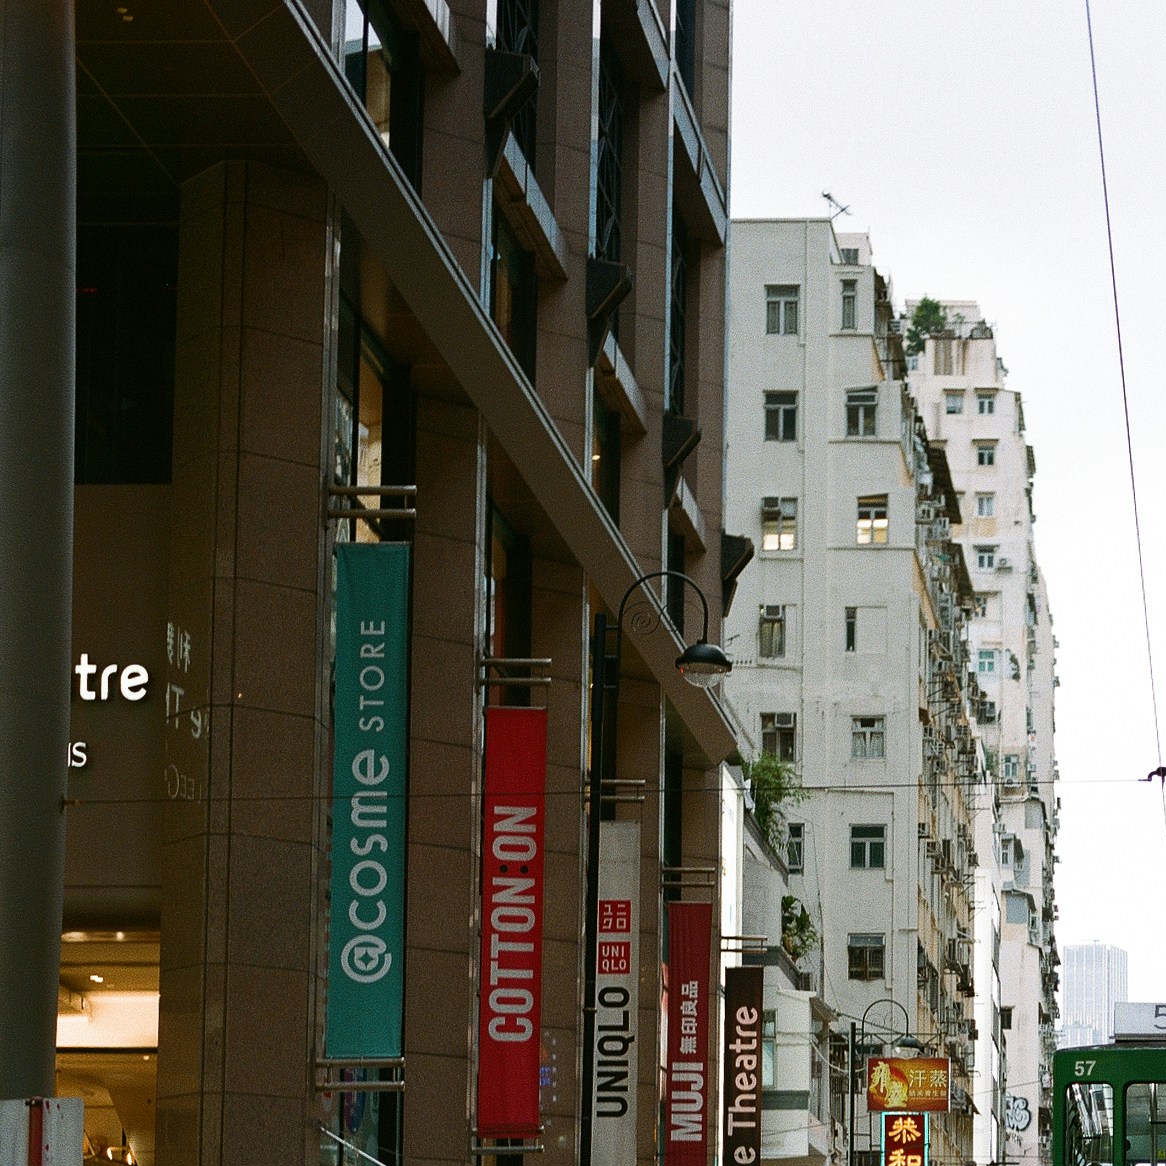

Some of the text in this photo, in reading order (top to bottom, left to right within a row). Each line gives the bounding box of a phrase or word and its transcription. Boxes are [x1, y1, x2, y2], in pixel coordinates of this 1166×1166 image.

[341, 620, 392, 984] @cosme STORE
[596, 985, 635, 1119] UNIQLO
[671, 980, 704, 1142] MUJI 無印良品
[728, 1006, 758, 1136] Theatre
[909, 1070, 947, 1088] 汗蒸
[1074, 1061, 1096, 1076] 57
